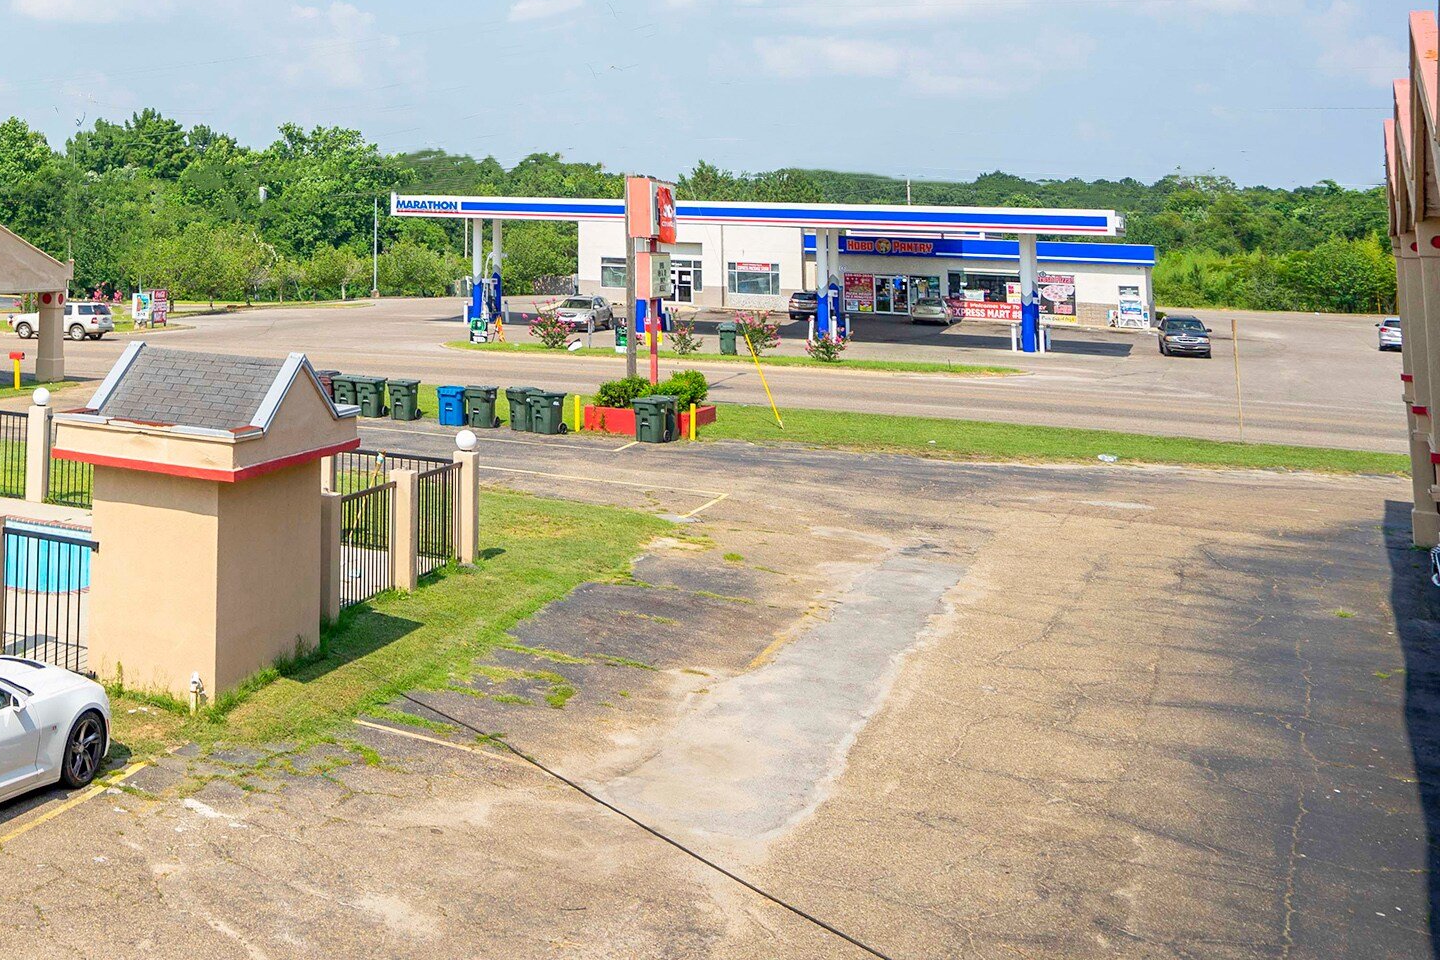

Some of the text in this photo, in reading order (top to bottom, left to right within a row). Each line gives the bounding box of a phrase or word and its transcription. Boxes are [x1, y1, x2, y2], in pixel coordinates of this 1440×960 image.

[396, 200, 458, 210] MARATHON
[847, 240, 933, 253] HOBO PANTRY
[953, 307, 985, 318] EXPRESS
[988, 309, 1010, 318] MART
